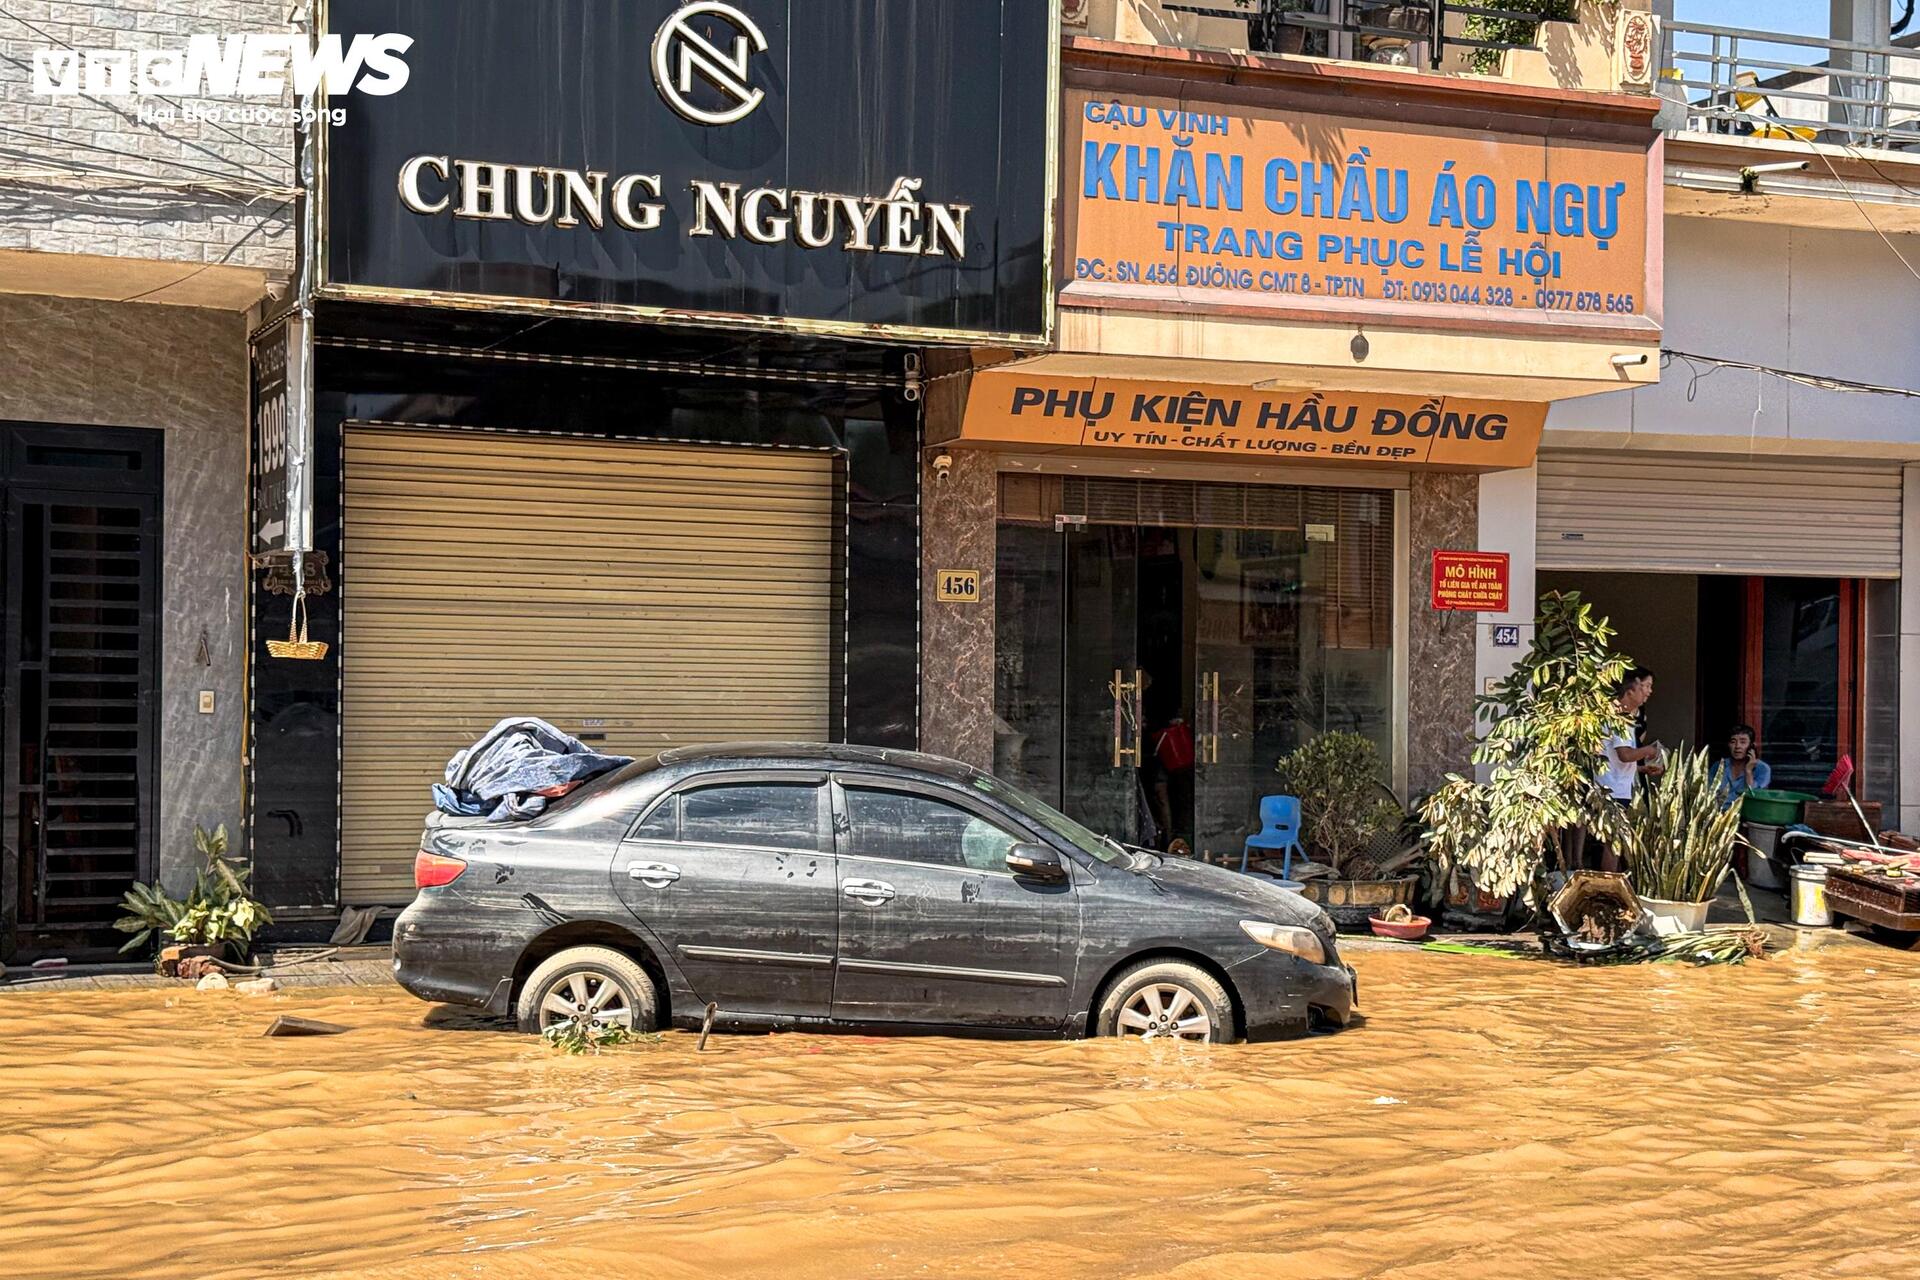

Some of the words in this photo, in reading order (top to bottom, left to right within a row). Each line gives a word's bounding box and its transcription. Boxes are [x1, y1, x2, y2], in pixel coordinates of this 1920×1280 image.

[398, 154, 664, 232] CHUNG
[689, 176, 973, 262] NGUYỄN
[1084, 135, 1243, 211] KHĂN
[1264, 146, 1409, 224] CHẦU
[1429, 160, 1497, 229] ÁO
[1516, 179, 1625, 250] NGỰ
[1157, 221, 1303, 260] TRANG
[1318, 234, 1425, 275] PHỤC
[1439, 231, 1483, 273] LỄ
[1499, 242, 1561, 285] HỘI
[1116, 261, 1139, 283] SN
[1145, 264, 1178, 285] 456
[1325, 275, 1365, 297] TPTN
[1486, 286, 1513, 307] 328
[1536, 289, 1573, 311] 0977
[1576, 291, 1601, 311] 878
[1606, 294, 1634, 313] 565
[257, 392, 286, 475] 1999
[1011, 387, 1115, 427] PHỤ
[1130, 390, 1241, 432] KIỆN
[1256, 392, 1358, 433] HẦU
[1371, 398, 1508, 440] ĐỒNG
[1094, 431, 1126, 442] UY
[1133, 430, 1167, 445] TÍN
[1182, 431, 1240, 449] CHẤT
[1246, 439, 1317, 454] LƯỢNG
[1331, 440, 1372, 456] BỀN
[1376, 446, 1416, 460] ĐẸP
[942, 576, 975, 595] 456
[1445, 564, 1465, 579] MÔ
[1468, 564, 1497, 579] HÌNH
[1496, 628, 1518, 644] 454
